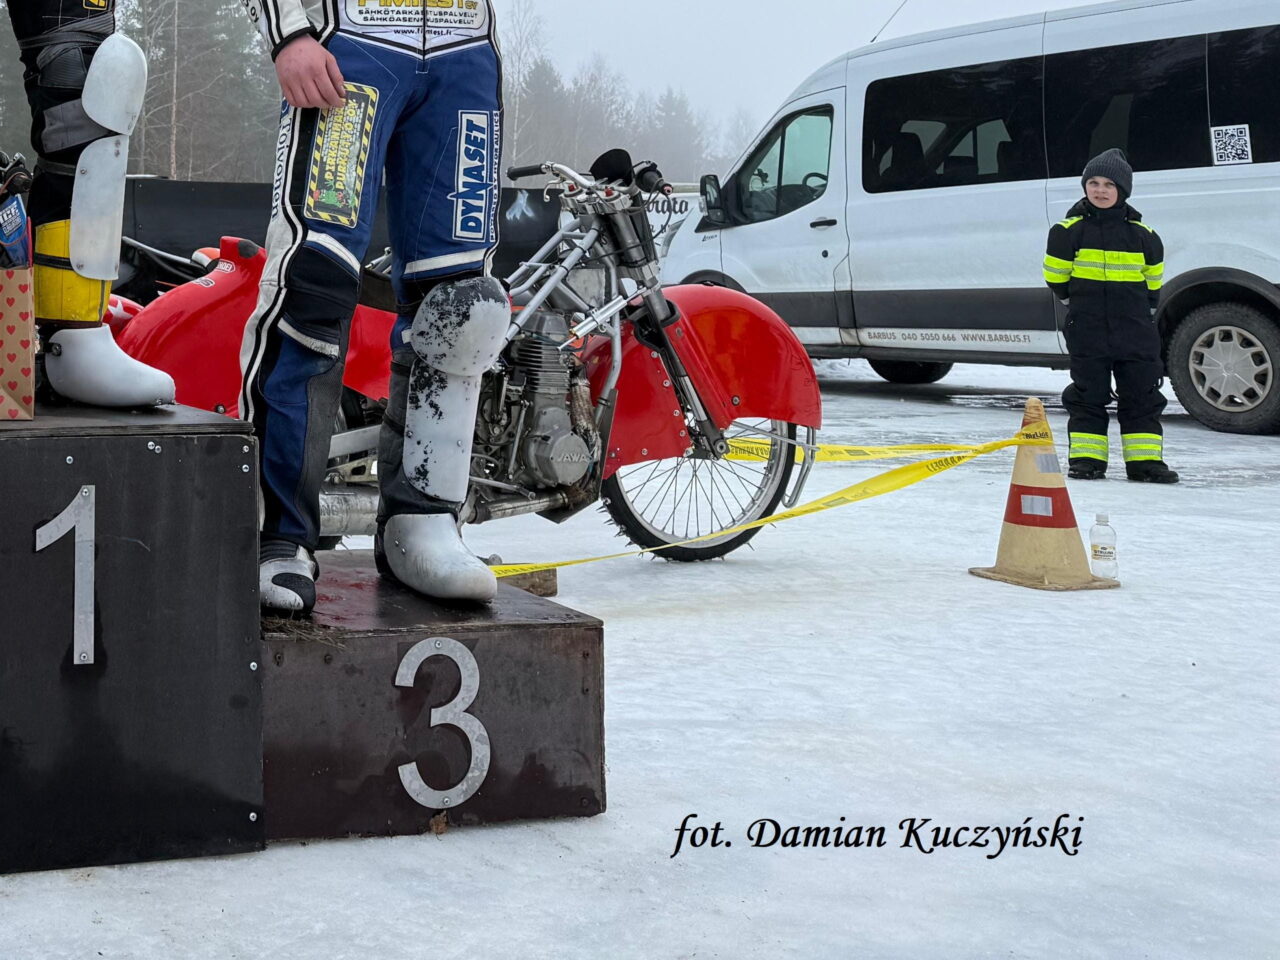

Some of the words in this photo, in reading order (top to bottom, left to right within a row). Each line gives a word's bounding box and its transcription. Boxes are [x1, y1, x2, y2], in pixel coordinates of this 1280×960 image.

[271, 118, 293, 219] Toivonen
[454, 118, 488, 233] DYNASET
[868, 332, 896, 340] BARBUS
[901, 332, 918, 341] 040
[920, 332, 940, 341] 5050
[942, 333, 956, 341] 666
[960, 333, 1031, 343] WWW.BARBUS.FI
[35, 484, 97, 665] 1
[395, 637, 492, 809] 3
